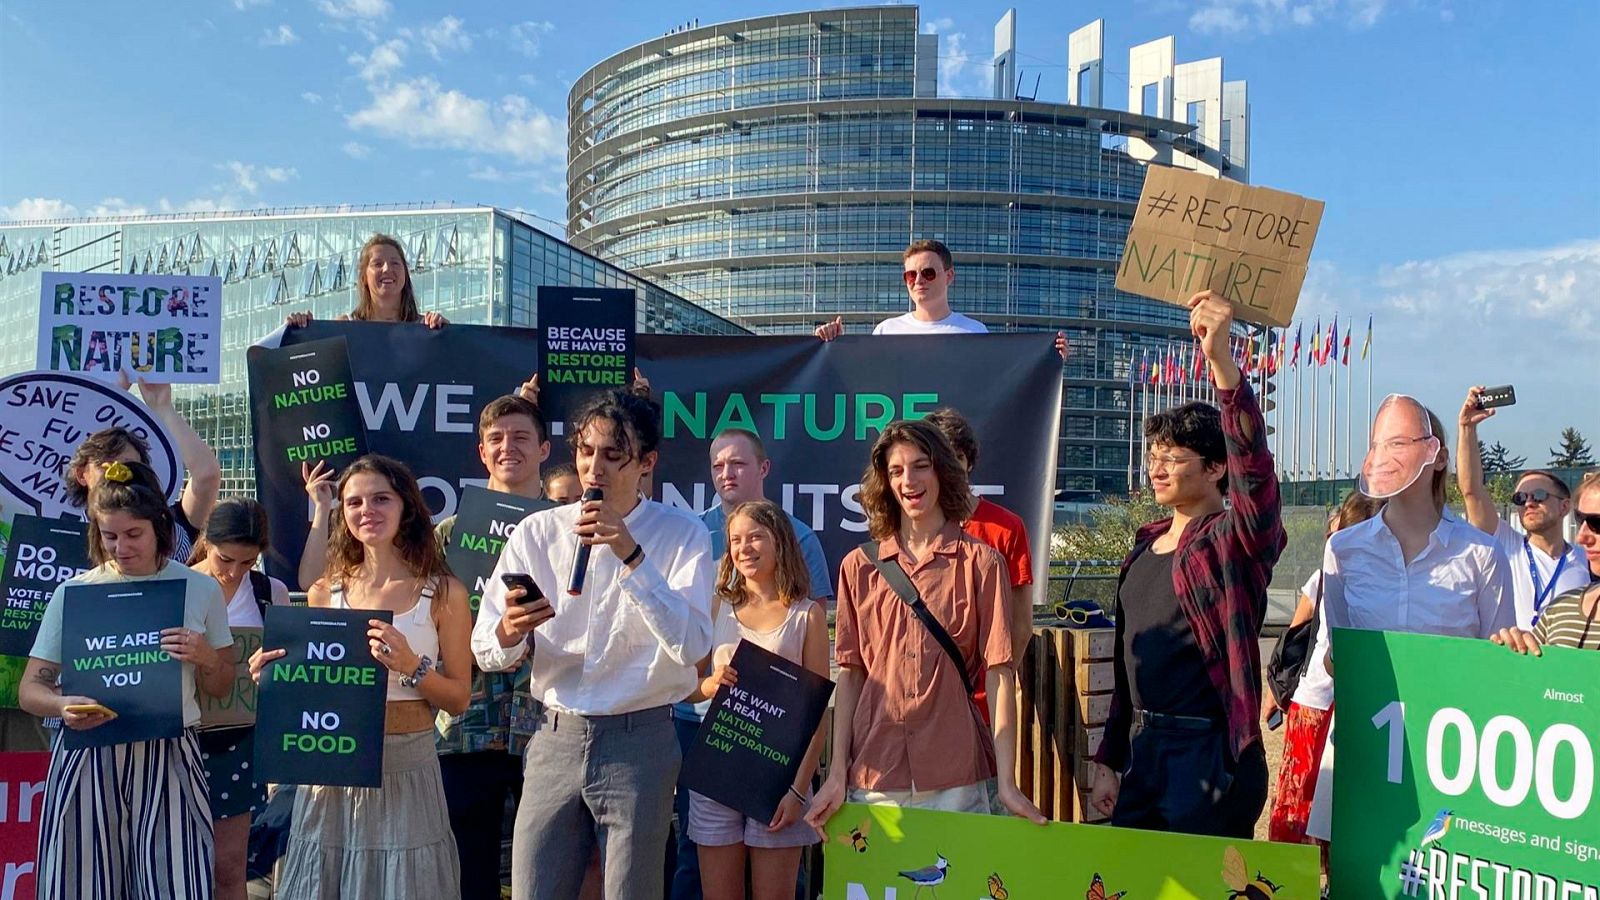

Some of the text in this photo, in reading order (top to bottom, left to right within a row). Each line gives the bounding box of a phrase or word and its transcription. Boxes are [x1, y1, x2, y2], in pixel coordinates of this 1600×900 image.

[1147, 190, 1309, 249] #RESTORE
[1122, 239, 1281, 310] NATURE
[53, 282, 209, 318] RESTORE
[547, 326, 626, 342] BECAUSE
[50, 324, 208, 373] NATURE
[547, 340, 626, 352] WE HAVE TO
[547, 353, 626, 367] RESTORE
[292, 369, 320, 388] NO
[547, 369, 626, 385] NATURE
[7, 384, 80, 415] SAVE
[274, 383, 348, 409] NATURE
[353, 381, 474, 433] WE
[302, 423, 331, 441] NO
[286, 437, 357, 462] FUTURE
[17, 543, 57, 564] DO
[6, 597, 31, 610] THE
[9, 587, 42, 600] VOTE
[1, 619, 31, 631] LAW
[85, 631, 160, 651] WE ARE
[307, 641, 346, 661] NO
[73, 650, 171, 671] WATCHING
[102, 671, 142, 688] YOU
[273, 663, 376, 686] NATURE
[729, 687, 786, 719] WE WANT
[1543, 688, 1584, 704] Almost
[301, 711, 340, 730] NO
[722, 697, 762, 723] A REAL
[716, 709, 764, 739] NATURE
[283, 733, 357, 755] FOOD
[705, 735, 734, 754] LAW
[711, 722, 790, 766] RESTORATION
[1455, 816, 1526, 843] messages
[1530, 832, 1560, 852] and
